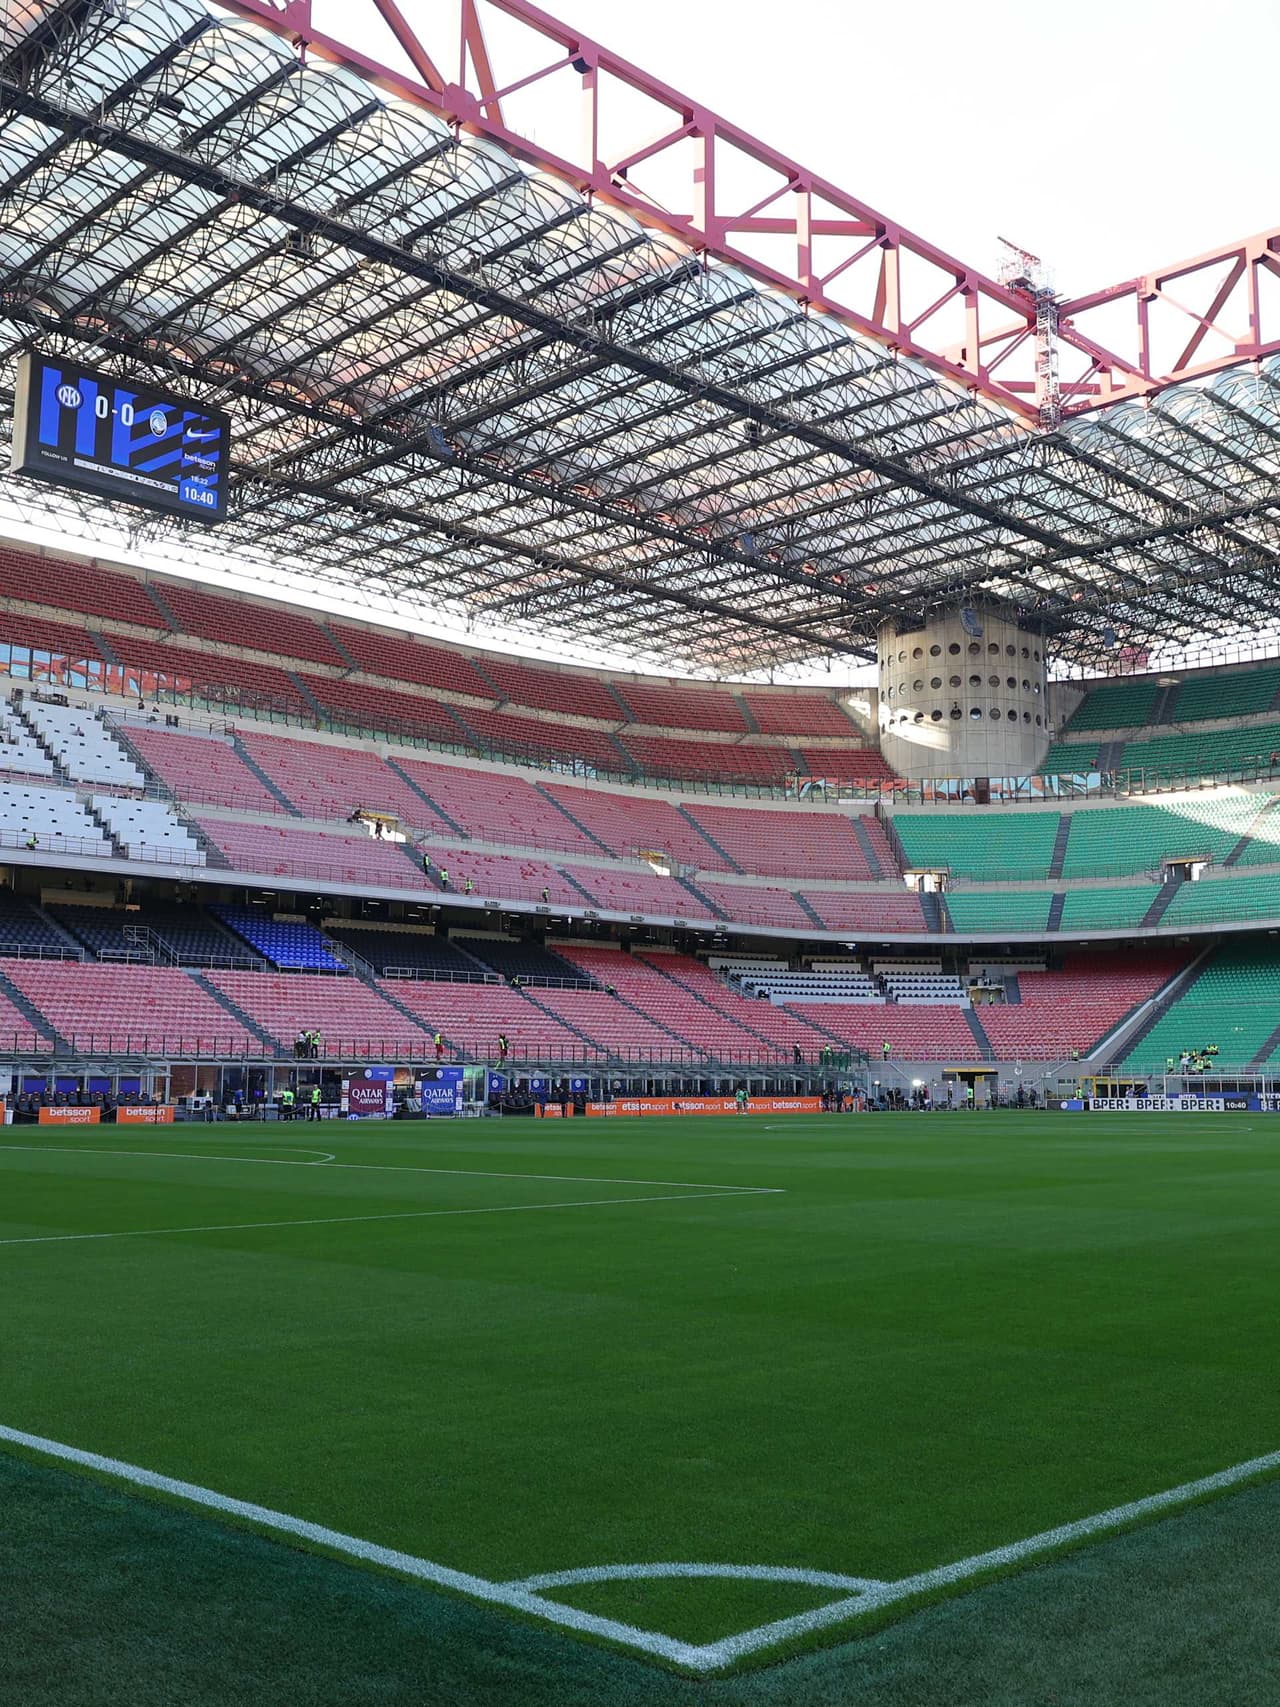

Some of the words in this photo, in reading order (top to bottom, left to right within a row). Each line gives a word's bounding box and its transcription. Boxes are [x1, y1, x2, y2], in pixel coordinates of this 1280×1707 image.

[41, 450, 60, 459] FOLLOW
[184, 453, 216, 467] betsson
[184, 486, 214, 505] 10:40
[352, 1088, 383, 1100] QATAR
[424, 1088, 453, 1099] QATAR
[622, 1102, 651, 1111] etsson
[772, 1100, 802, 1109] betsson
[49, 1108, 91, 1116] betsson
[126, 1107, 166, 1116] betsson
